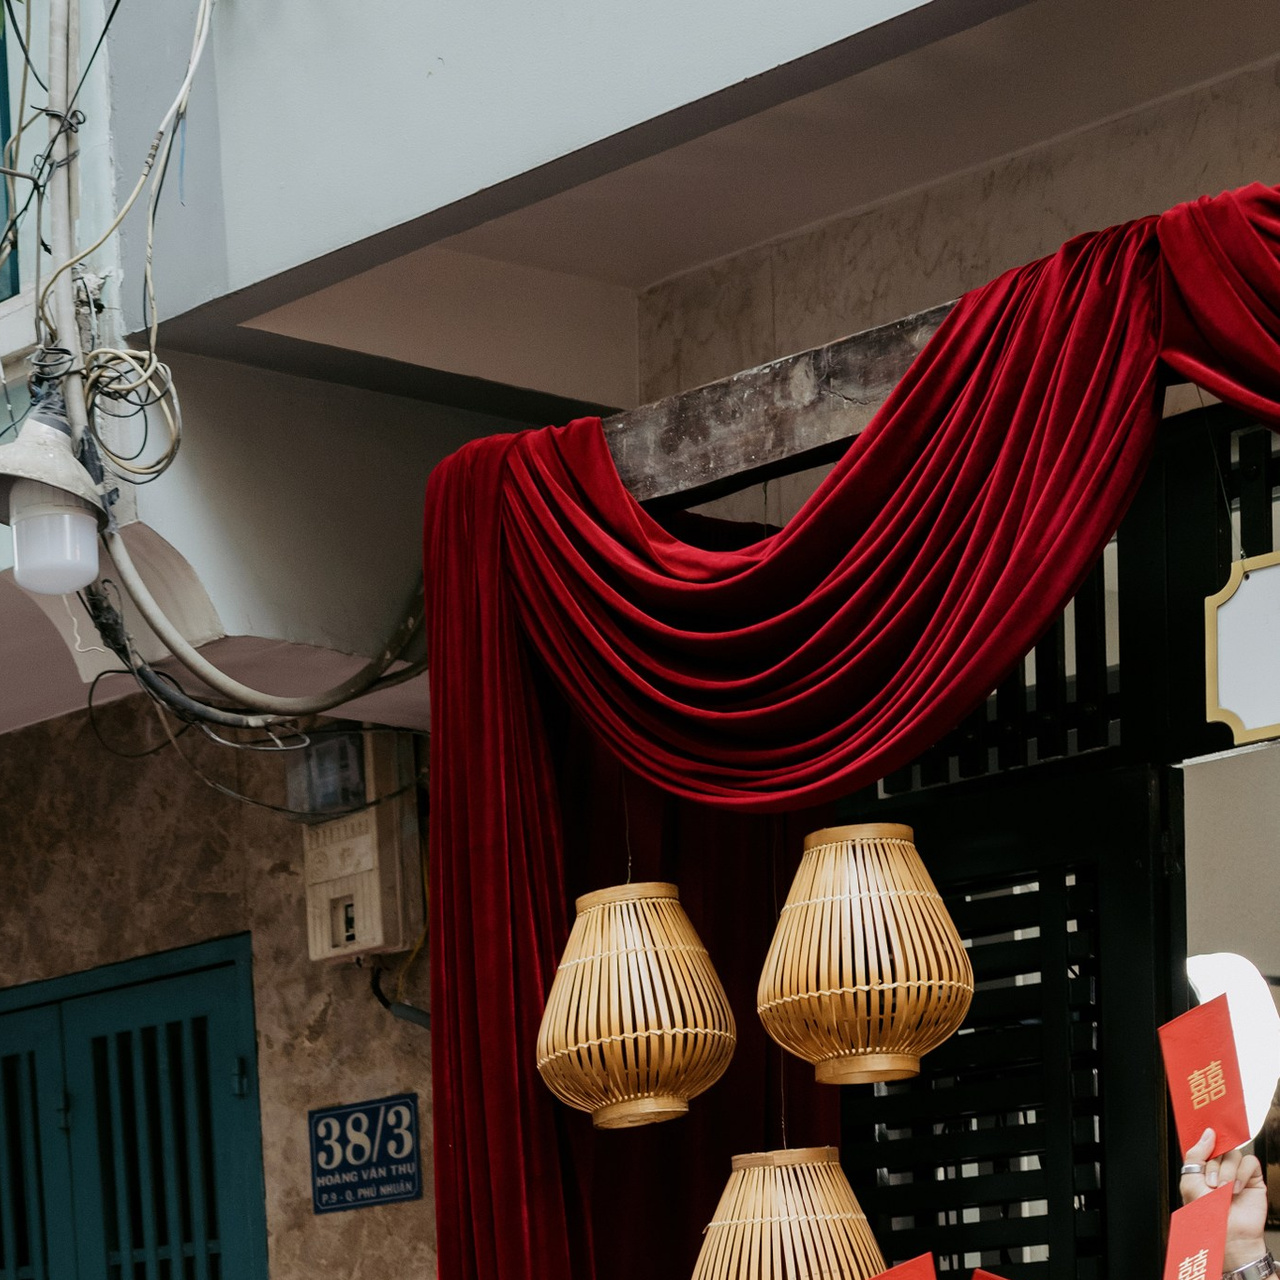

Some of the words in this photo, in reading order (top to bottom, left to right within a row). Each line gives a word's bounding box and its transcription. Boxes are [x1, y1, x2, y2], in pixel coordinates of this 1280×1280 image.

[317, 1105, 413, 1170] 38/3
[317, 1171, 358, 1187] HOÀNG
[390, 1163, 415, 1177] THỤ
